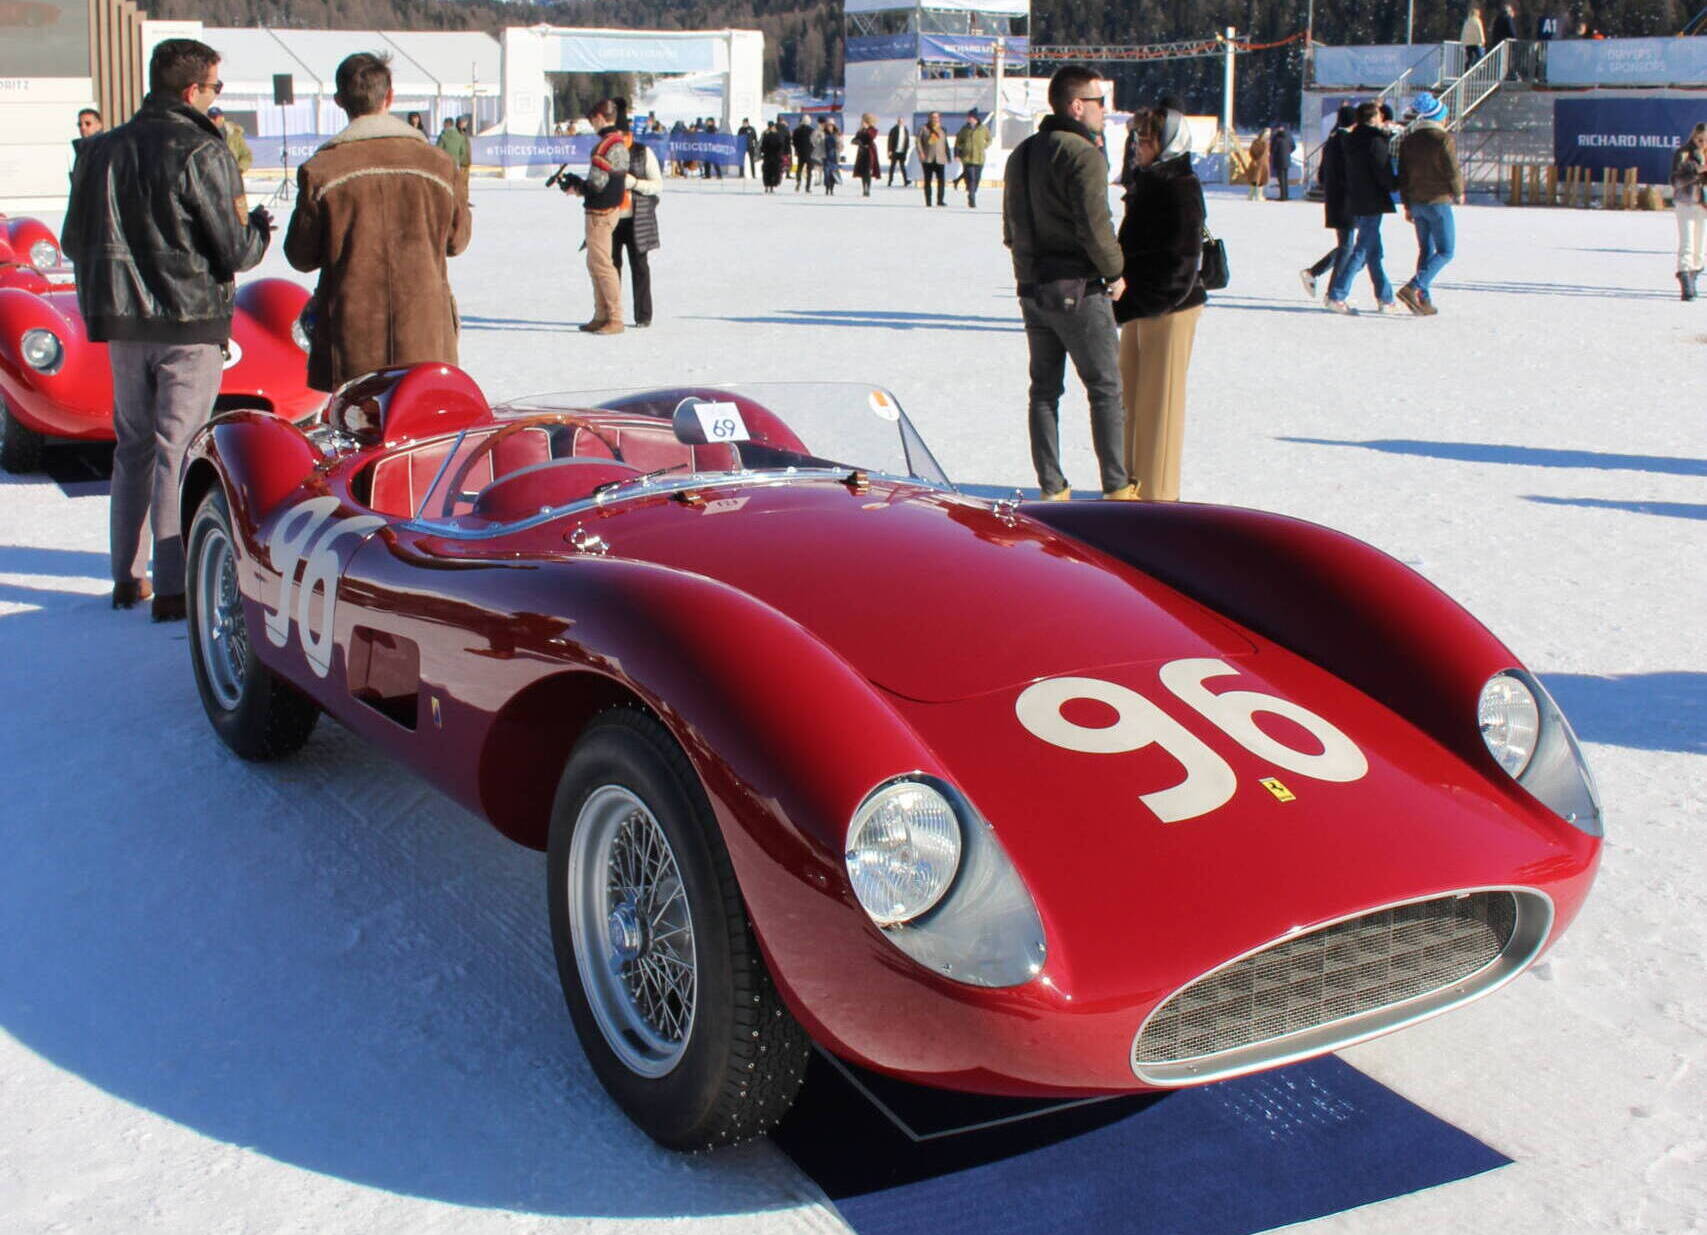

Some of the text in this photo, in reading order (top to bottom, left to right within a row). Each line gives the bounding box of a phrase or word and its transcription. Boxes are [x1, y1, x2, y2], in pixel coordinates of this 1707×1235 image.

[1577, 134, 1681, 148] RICHARD MILLE
[712, 418, 736, 438] 69
[263, 495, 388, 678] 96
[1015, 658, 1369, 824] 96
